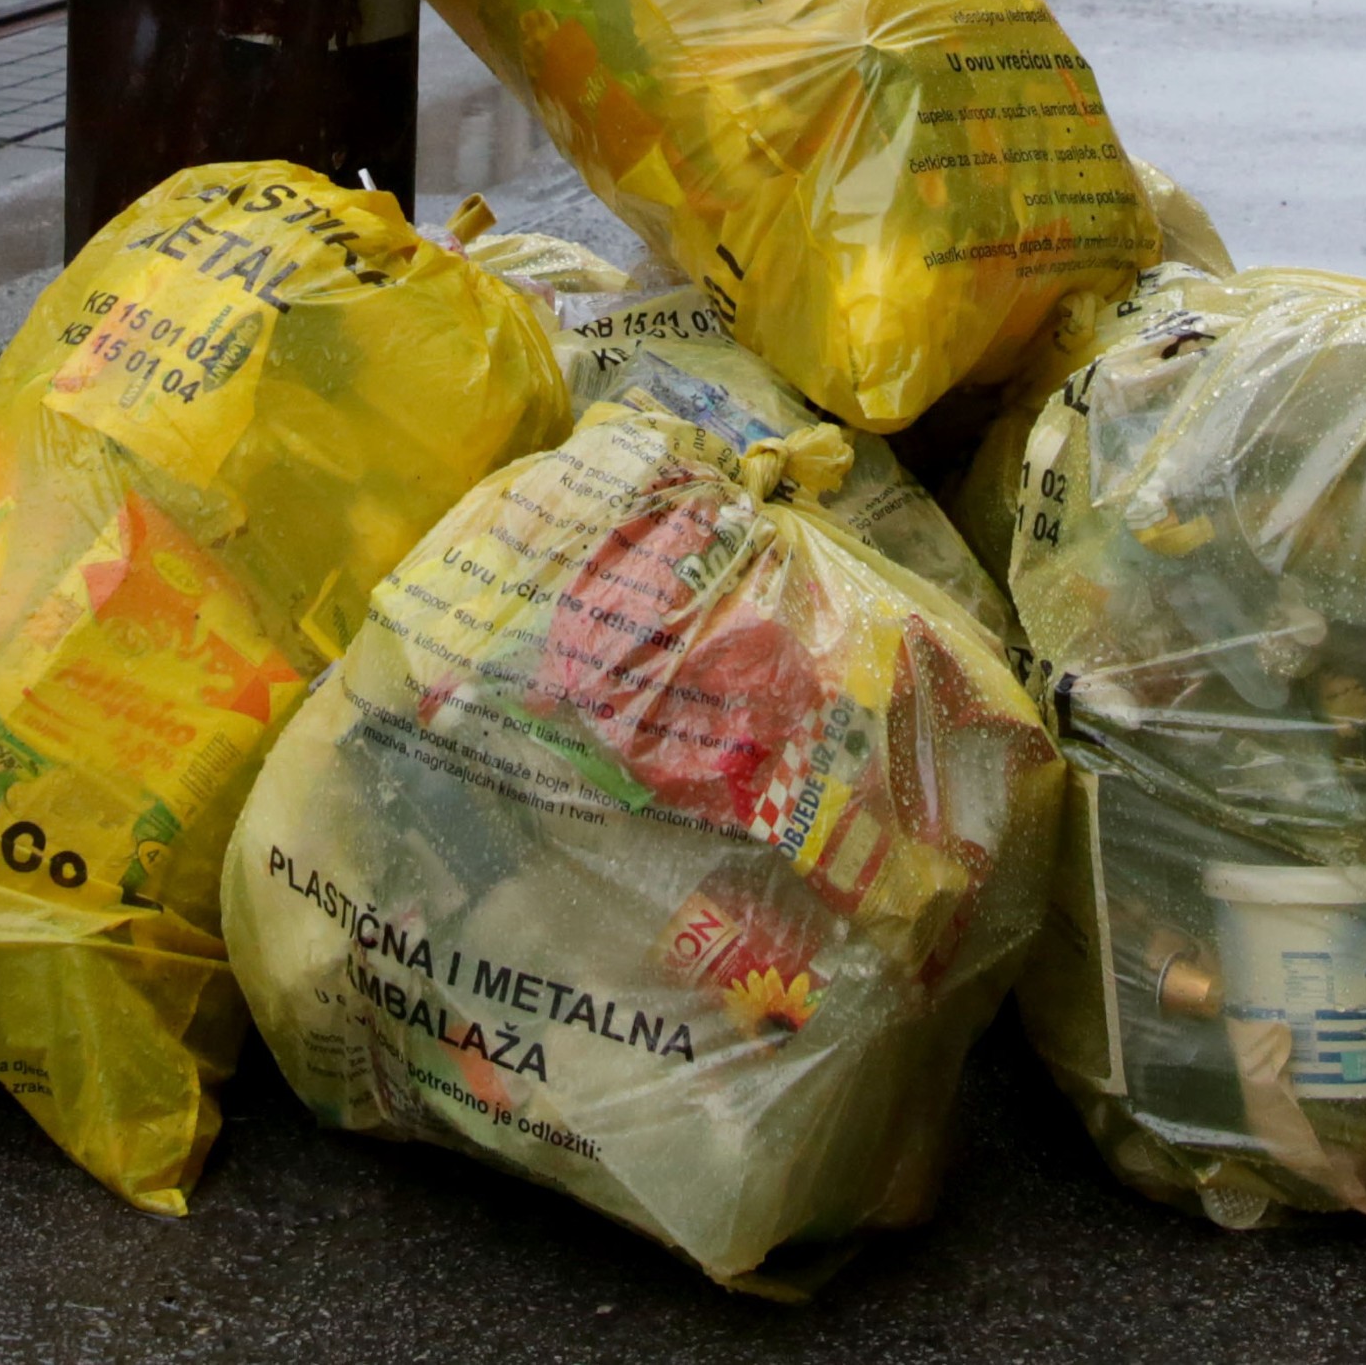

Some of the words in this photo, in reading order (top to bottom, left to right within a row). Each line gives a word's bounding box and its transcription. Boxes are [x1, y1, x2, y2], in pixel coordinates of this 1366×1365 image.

[946, 52, 962, 73] U
[965, 53, 994, 72] ovu
[996, 50, 1052, 70] vrećicu
[1054, 54, 1075, 70] ne
[909, 155, 956, 175] četkice
[958, 154, 972, 167] za
[1095, 190, 1115, 206] pod
[83, 289, 119, 315] KB
[118, 302, 153, 331] 15
[151, 318, 186, 347] 01
[186, 335, 227, 373] 02
[58, 321, 93, 346] KB
[92, 333, 127, 362] 15
[125, 348, 161, 380] 01
[161, 368, 201, 405] 04
[1040, 468, 1068, 504] 02
[1032, 511, 1061, 548] 04
[442, 546, 463, 564] U
[460, 558, 497, 586] ovu
[404, 583, 453, 615] stiropor,
[379, 612, 412, 640] zube,
[442, 692, 500, 723] limenke
[502, 716, 533, 737] pod
[535, 723, 590, 758] tlakom,
[363, 723, 412, 758] maziva,
[414, 746, 496, 792] nagrizajućih
[498, 782, 555, 814] kiselina
[568, 802, 610, 829] tvari.
[418, 726, 460, 755] poput
[461, 744, 532, 782] ambalaže
[577, 784, 637, 818] lakova,
[640, 804, 715, 836] motornih
[269, 844, 435, 979] PLASTIČNA
[447, 951, 462, 987] I
[473, 959, 696, 1063] METALNA
[346, 953, 548, 1083] AMBALAŽA
[406, 1057, 490, 1115] potrebno
[492, 1101, 513, 1127] je
[517, 1120, 603, 1163] odložiti:
